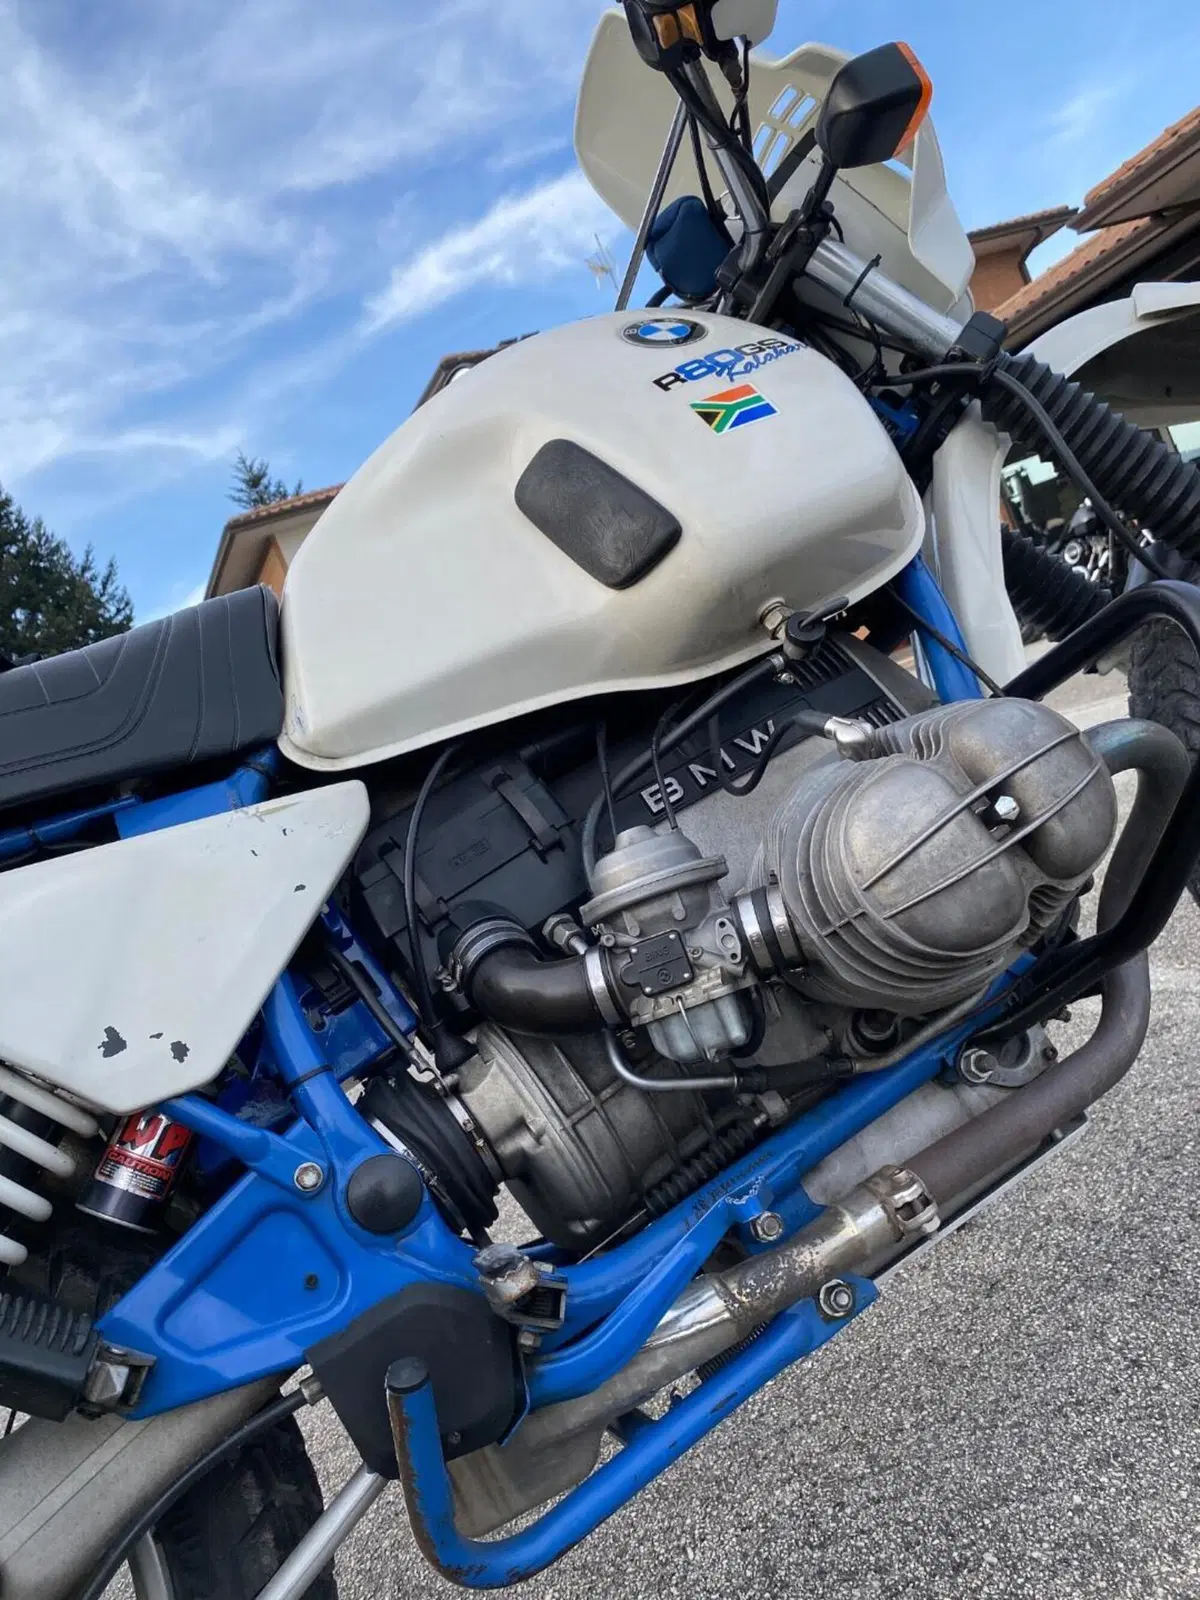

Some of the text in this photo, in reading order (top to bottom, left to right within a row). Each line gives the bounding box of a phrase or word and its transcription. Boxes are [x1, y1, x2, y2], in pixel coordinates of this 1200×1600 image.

[640, 719, 775, 814] BMW
[118, 1112, 192, 1160] WP
[108, 1150, 172, 1182] CAUTION
